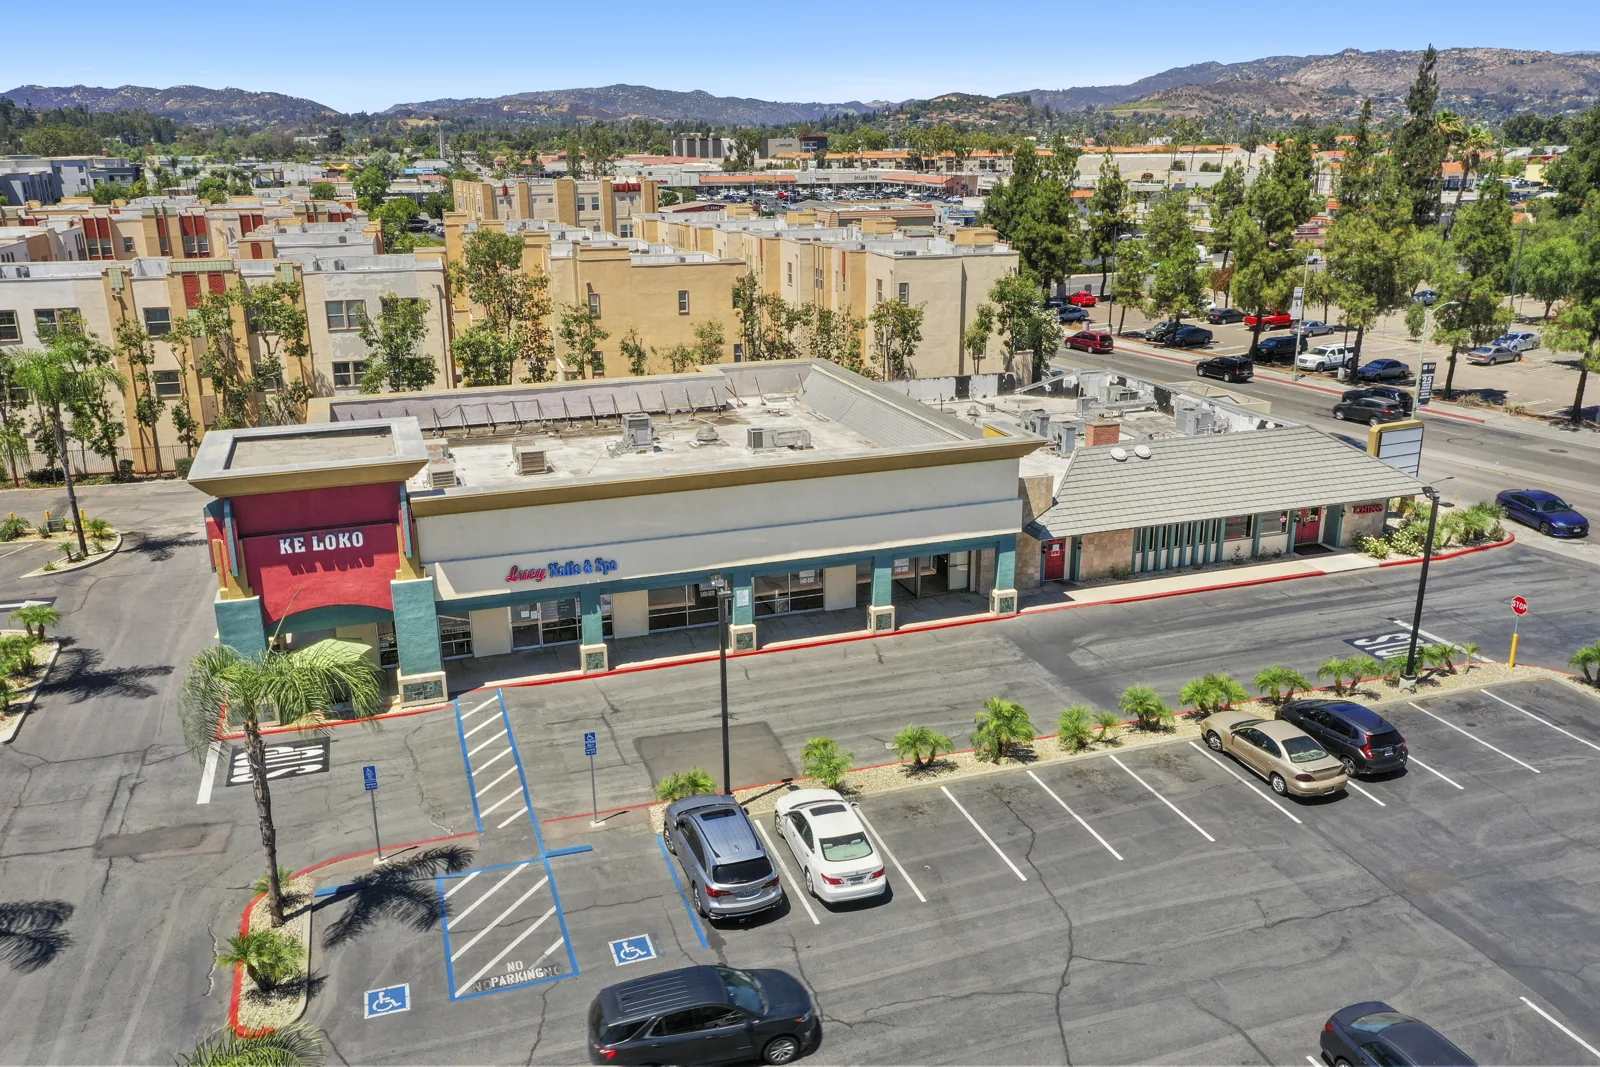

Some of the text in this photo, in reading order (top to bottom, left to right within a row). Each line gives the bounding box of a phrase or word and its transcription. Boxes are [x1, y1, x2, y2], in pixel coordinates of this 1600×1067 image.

[279, 531, 364, 555] KE LOKO
[505, 558, 618, 582] Lucy Nails & Spa
[1511, 600, 1528, 611] STOP
[506, 960, 524, 973] NO
[490, 967, 545, 988] PARKING
